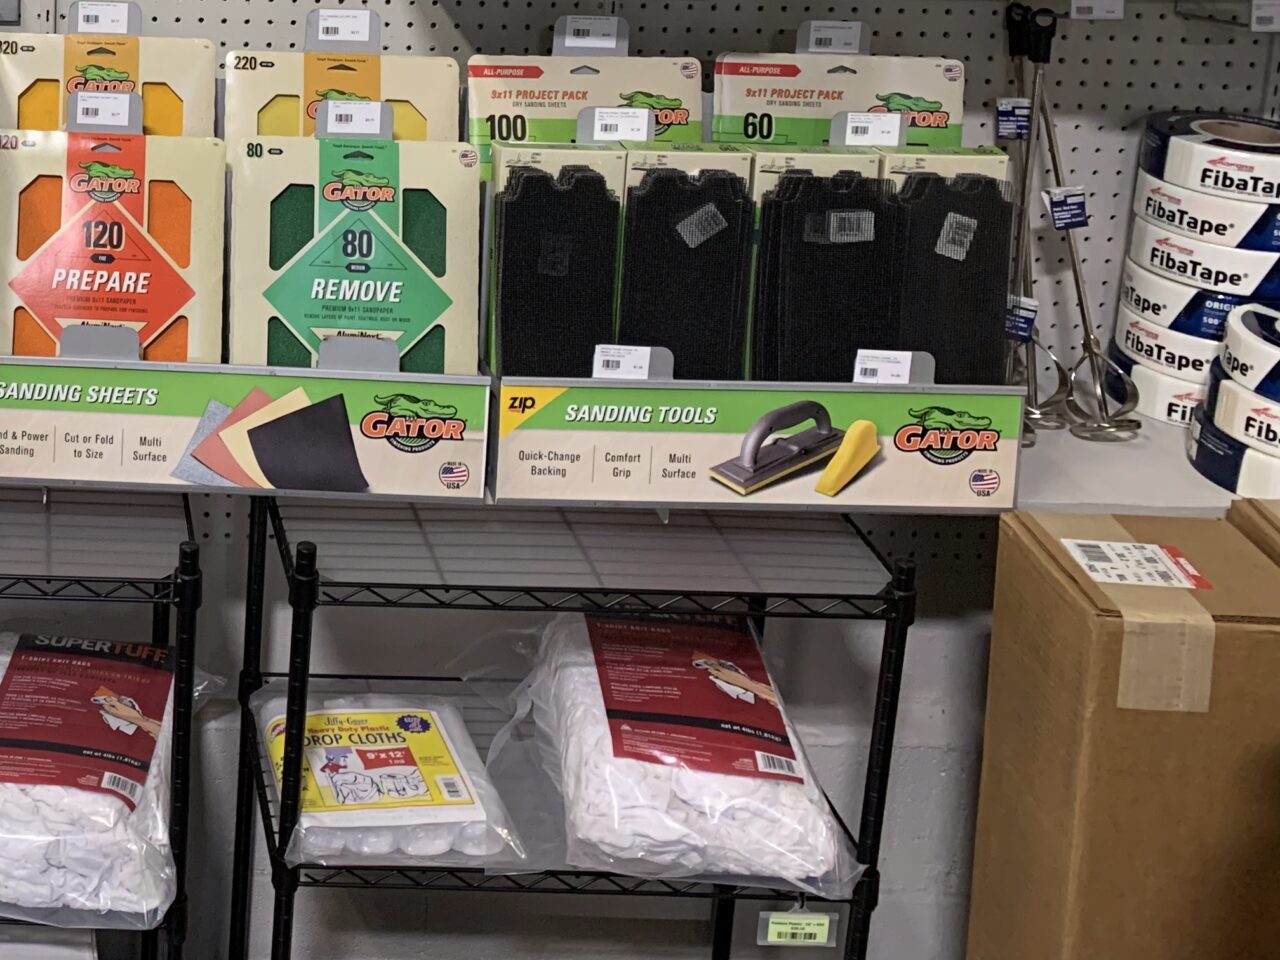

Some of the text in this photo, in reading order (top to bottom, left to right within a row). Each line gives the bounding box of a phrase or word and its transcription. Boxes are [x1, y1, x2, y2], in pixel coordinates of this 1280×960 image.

[233, 56, 258, 71] 220
[483, 68, 525, 77] ALL-PURPOSE
[491, 90, 589, 101] 9x11 PROJECT PACK
[485, 114, 527, 141] 100
[743, 112, 774, 140] 60
[246, 143, 263, 158] 80
[69, 174, 141, 195] GATOR
[322, 182, 395, 203] GATOR
[83, 221, 123, 250] 120
[342, 229, 374, 259] 80
[52, 268, 152, 294] PREPARE
[311, 278, 404, 303] REMOVE
[87, 385, 159, 406] SHEETS
[565, 404, 717, 425] SANDING TOOLS
[360, 411, 466, 440] GATOR
[11, 430, 18, 441] &
[21, 430, 49, 443] Power
[64, 432, 114, 445] Cut or Fold
[139, 436, 163, 448] Multi
[894, 424, 1000, 452] GATOR
[74, 448, 104, 460] to Size
[133, 450, 168, 463] Surface
[518, 451, 581, 465] Quick-Change
[605, 452, 641, 464] Comfort
[669, 453, 692, 464] Multi
[530, 465, 567, 478] Backing
[613, 466, 632, 479] Grip
[661, 467, 697, 480] Surface
[446, 482, 461, 490] USA
[34, 635, 169, 662] SUPERTUFF
[349, 732, 406, 744] CLOTHS
